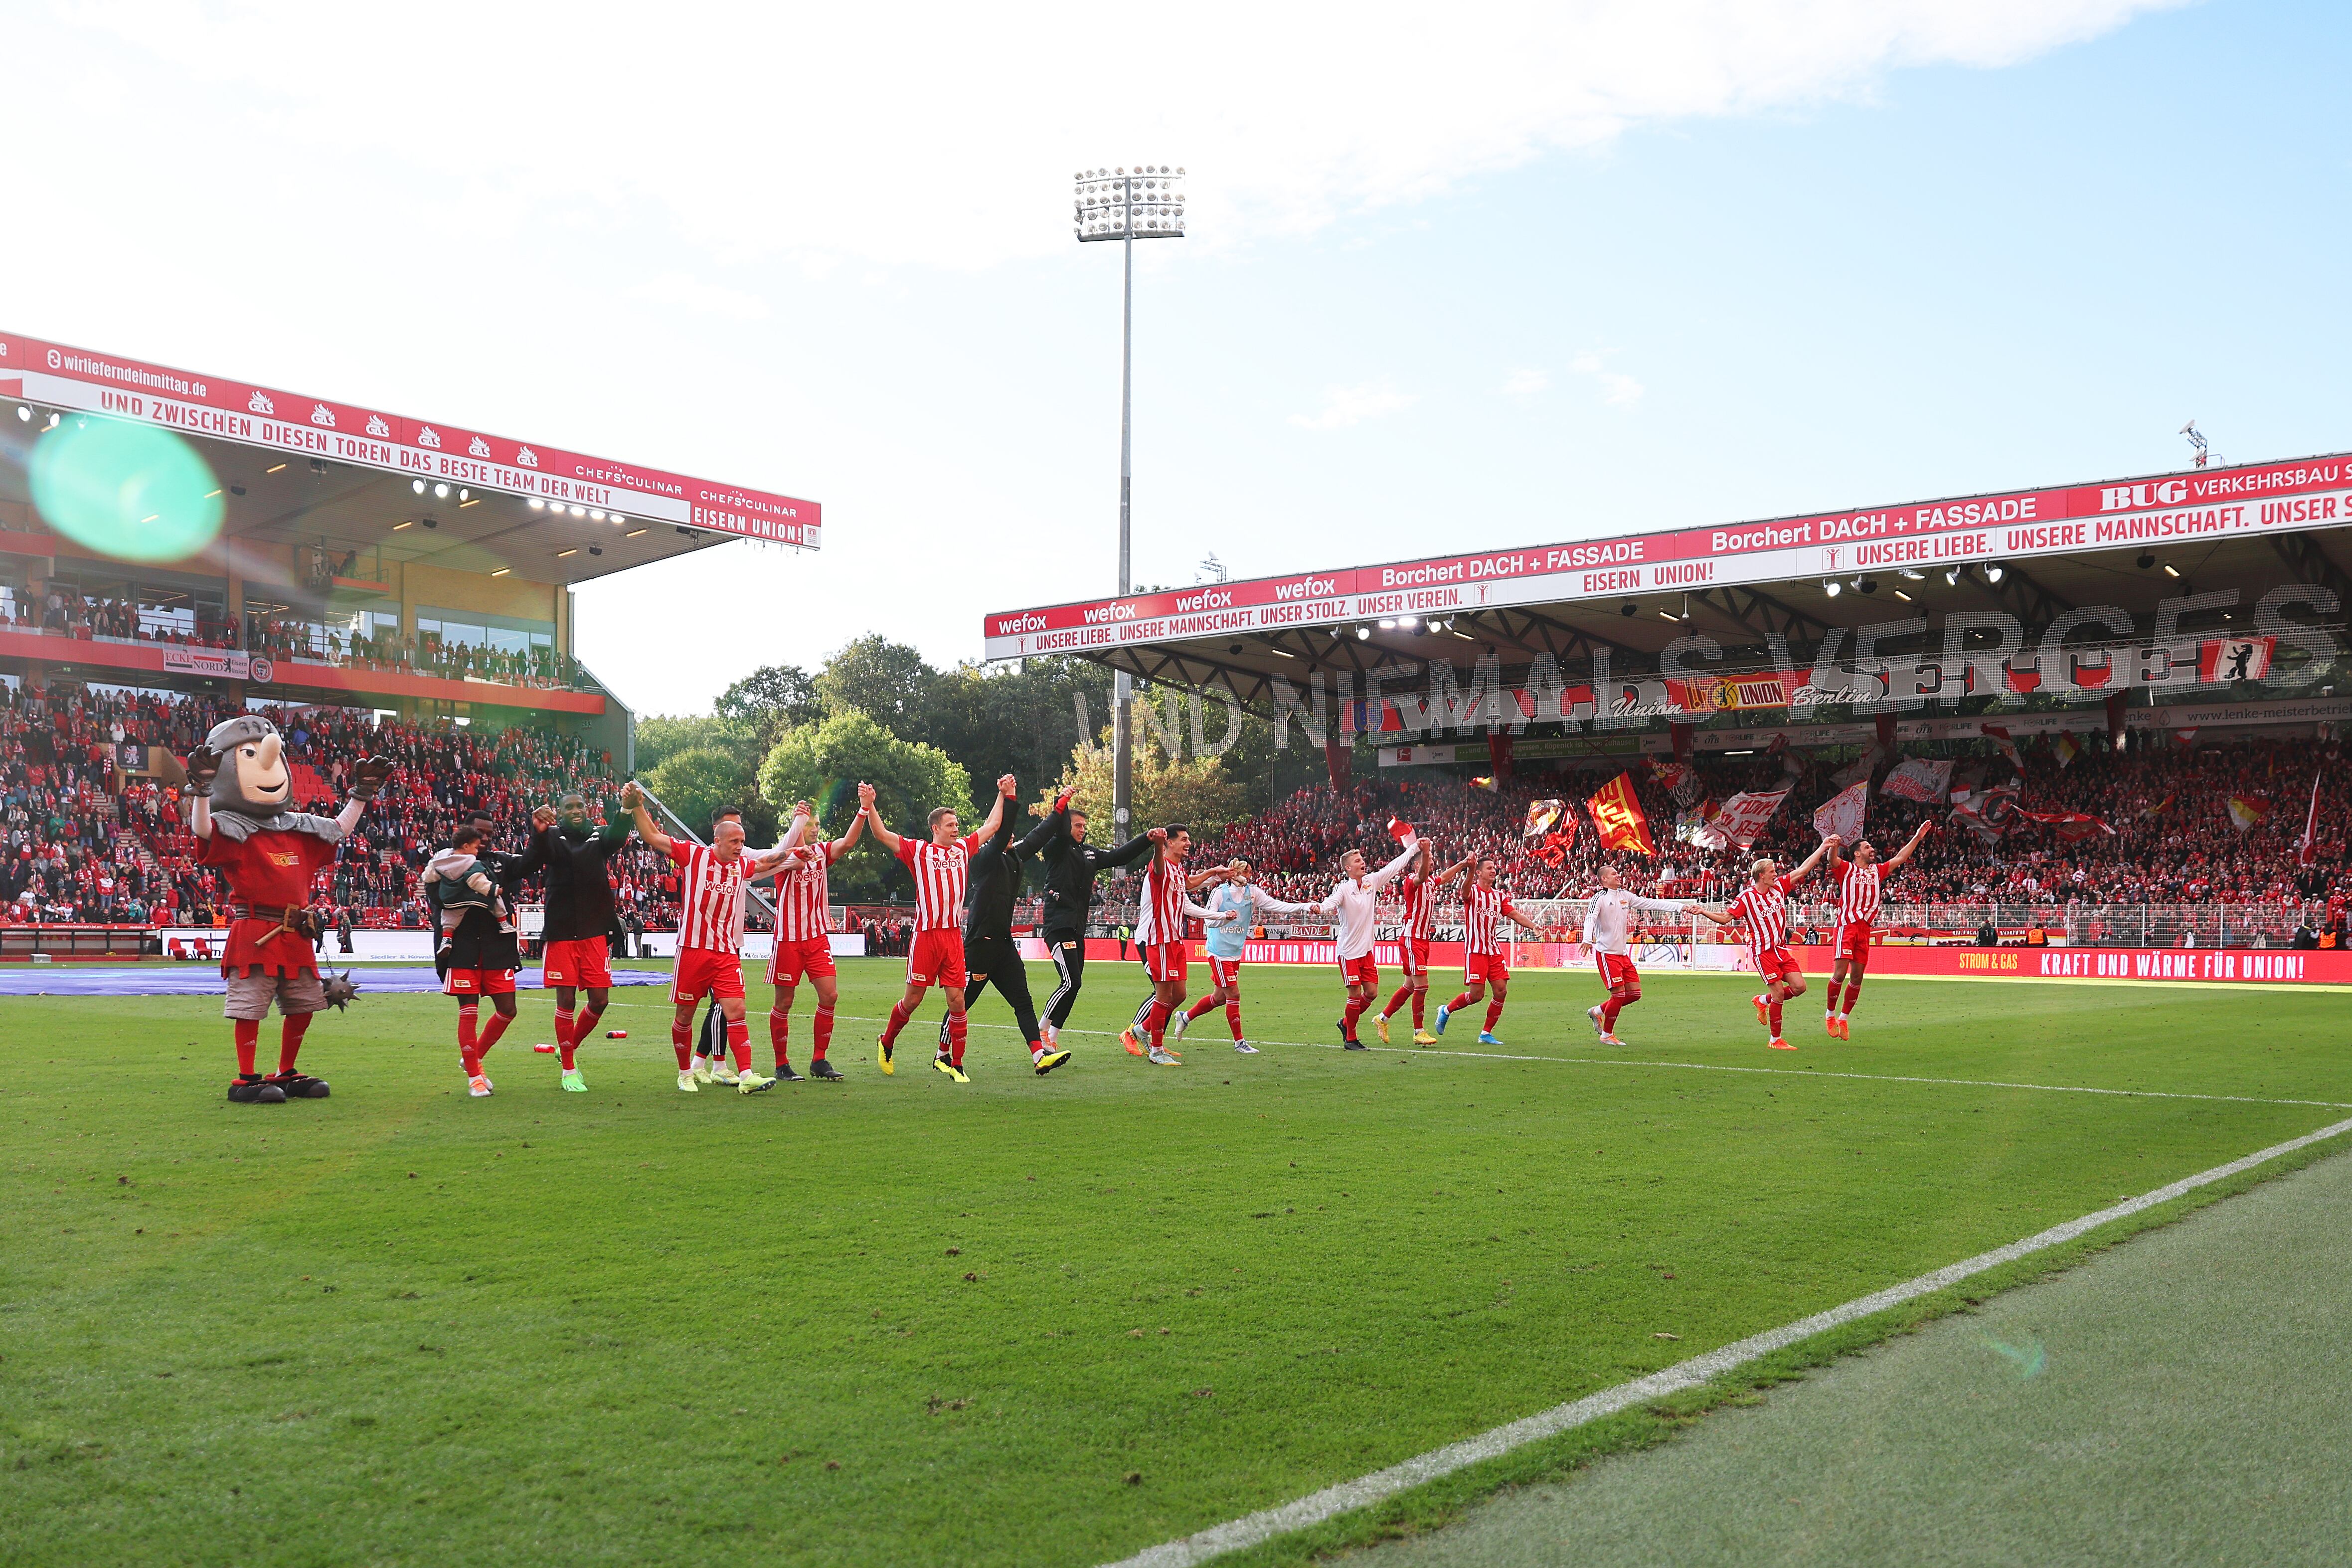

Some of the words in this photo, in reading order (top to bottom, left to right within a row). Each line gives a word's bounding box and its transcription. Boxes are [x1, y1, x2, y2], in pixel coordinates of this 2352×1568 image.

[64, 355, 207, 397] wirlieferndeinmittag.de
[102, 391, 142, 415] UND
[153, 401, 251, 437] ZWISCHEN
[263, 423, 327, 451] DIESEN
[336, 437, 390, 464] TOREN
[401, 450, 432, 471] DAS
[440, 457, 488, 482] BESTE
[494, 468, 534, 491] TEAM
[541, 477, 569, 498] DER
[575, 484, 611, 505] WELT
[2099, 479, 2189, 512] BUG
[2193, 465, 2339, 497] VERKEHRSBAU
[694, 506, 745, 531] EISERN
[752, 518, 802, 542] UNION!
[1712, 522, 1812, 552] Borchert
[1819, 514, 1886, 540] DACH
[1916, 497, 2036, 530] FASSADE
[1856, 539, 1929, 566] UNSERE
[1934, 532, 1994, 557] LIEBE.
[2008, 523, 2086, 551] UNSERE
[2095, 506, 2250, 542] MANNSCHAFT.
[2260, 498, 2336, 525] UNSER
[1382, 561, 1463, 587] Borchert
[1470, 555, 1523, 578] DACH
[1547, 540, 1644, 569] FASSADE
[1275, 575, 1335, 600] wefox
[1583, 569, 1641, 592] EISERN
[1654, 561, 1714, 586] UNION!
[1176, 589, 1232, 612] wefox
[999, 612, 1046, 635] wefox
[1036, 634, 1078, 651] UNSERE
[1080, 627, 1115, 646] LIEBE.
[1119, 621, 1164, 641] UNSERE
[1169, 610, 1255, 636] MANNSCHAFT.
[1260, 604, 1302, 625] UNSER
[1306, 600, 1350, 619] STOLZ.
[1357, 593, 1403, 615] UNSER
[1407, 588, 1463, 610] VEREIN.
[1084, 601, 1136, 624] wefox
[166, 653, 193, 663] ECKE
[193, 660, 223, 672] NORD
[1610, 696, 1684, 717] Union
[1738, 682, 1783, 704] UNION
[1792, 685, 1873, 706] Berlin
[2123, 711, 2151, 721] enke
[932, 856, 962, 870] wefox
[704, 878, 738, 896] wefox
[793, 868, 824, 883] wefox
[1854, 875, 1876, 885] wefox
[1476, 905, 1498, 918] wefox
[1759, 902, 1783, 917] wefox
[827, 949, 835, 966] 3
[1245, 944, 1275, 961] KRAFT
[1279, 944, 1299, 962] UND
[1374, 945, 1402, 963] NION
[1959, 953, 1989, 969] STROM
[1991, 953, 1998, 969] &
[2000, 954, 2017, 970] GAS
[2041, 953, 2090, 976] KRAFT
[2097, 954, 2128, 976] UND
[2137, 950, 2195, 978] WÄRME
[2203, 950, 2234, 978] FÜR
[2243, 956, 2304, 979] UNION!
